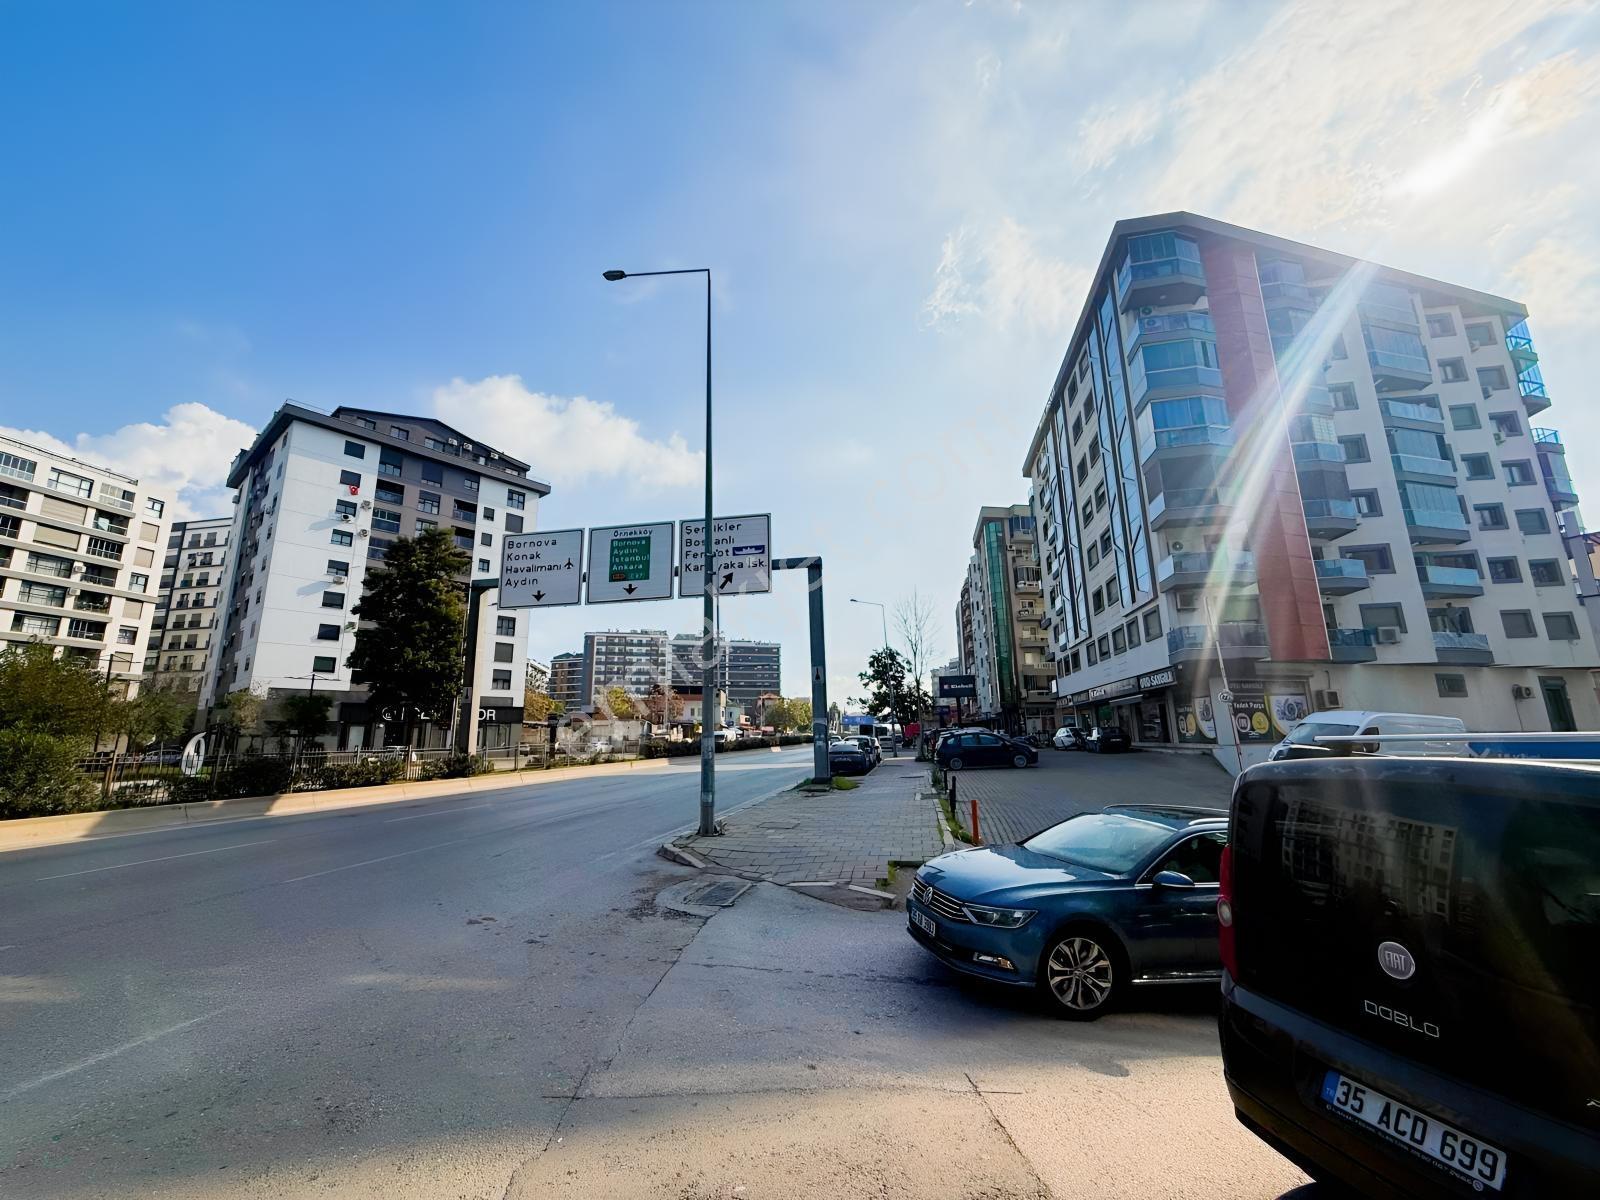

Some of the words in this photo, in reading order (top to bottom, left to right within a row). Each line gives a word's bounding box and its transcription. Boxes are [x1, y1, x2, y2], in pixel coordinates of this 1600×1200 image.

[507, 539, 557, 549] Bornova
[613, 539, 646, 547] Bornova
[685, 536, 735, 547] Bosanlı
[506, 551, 541, 562] Konak
[505, 564, 562, 574] Havalimanı
[505, 577, 539, 589] Aydın
[1384, 951, 1407, 972] FIAT
[1364, 1000, 1440, 1038] DOBLO
[1335, 1081, 1366, 1114] 35
[1377, 1101, 1428, 1146] ACD
[1439, 1130, 1499, 1182] 699
